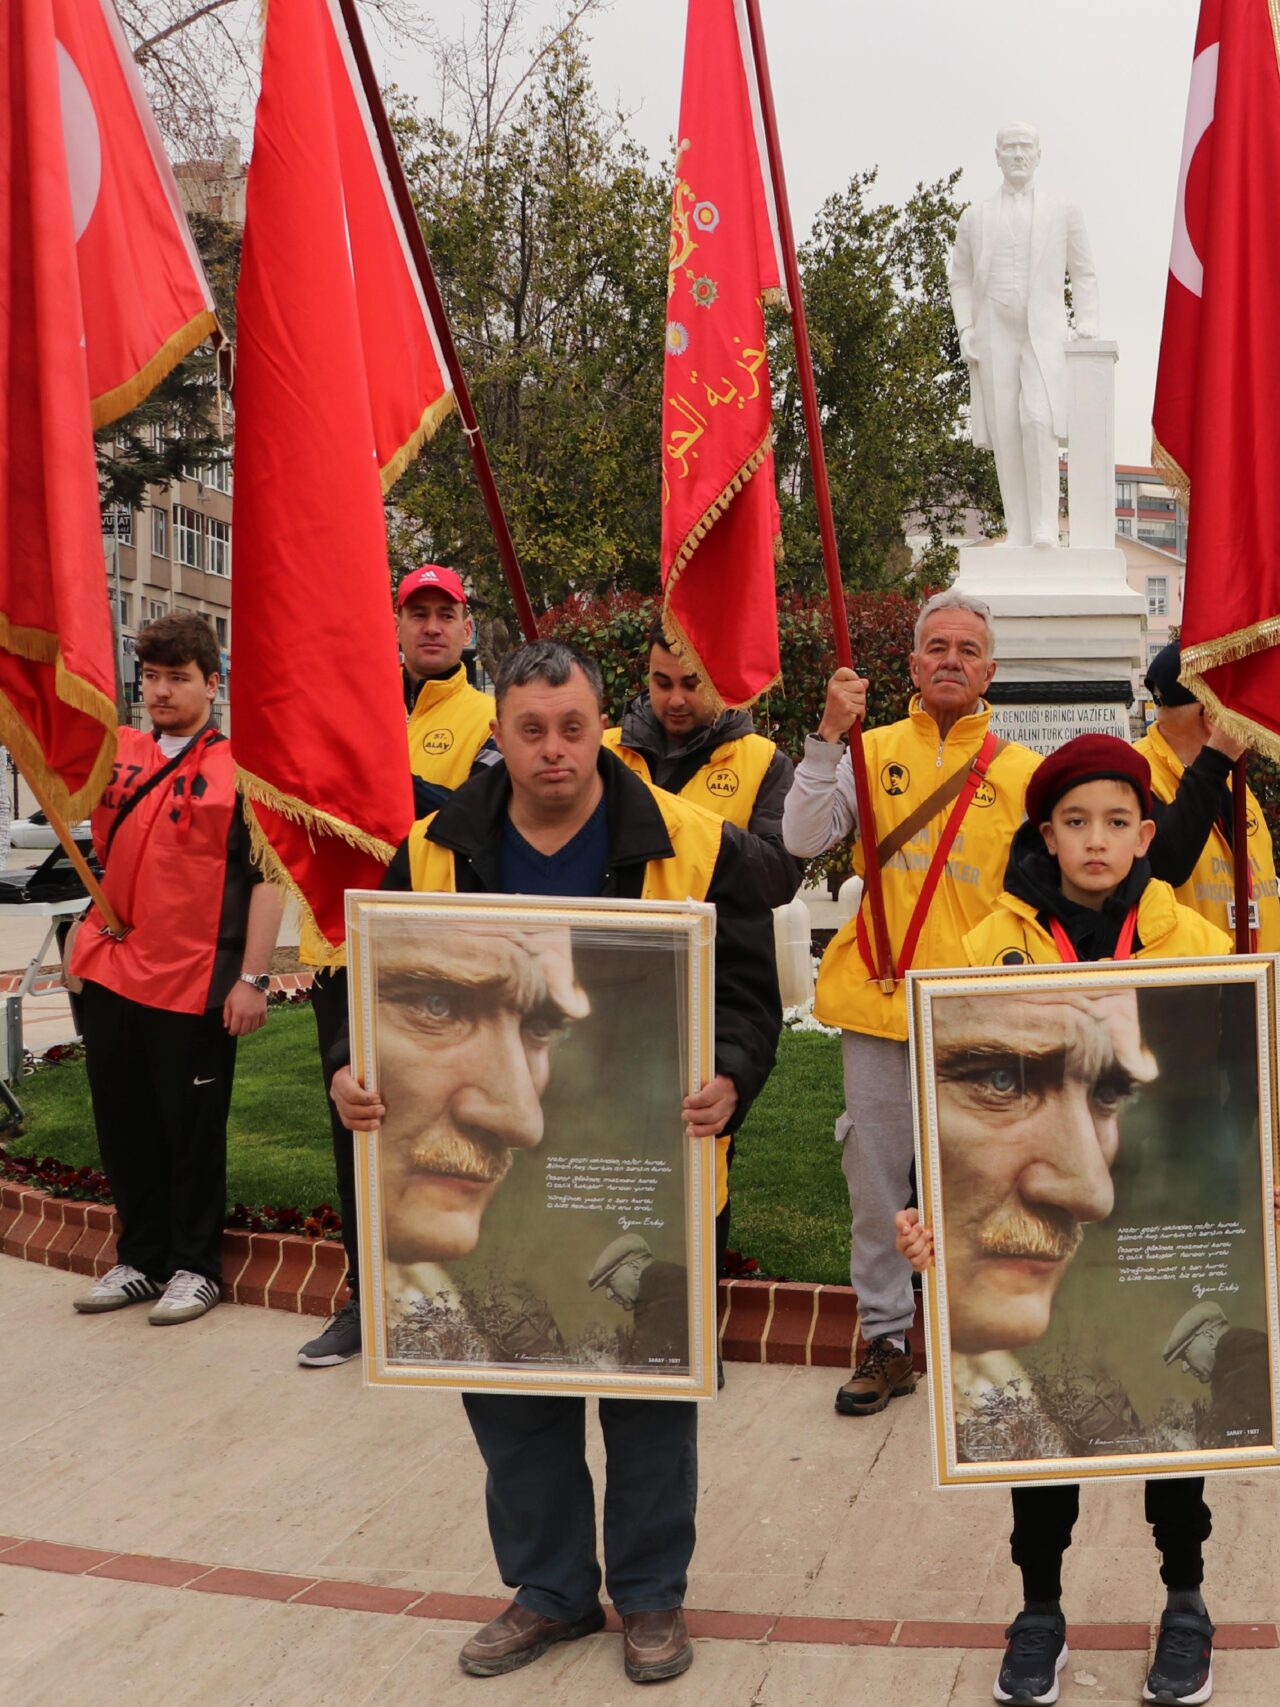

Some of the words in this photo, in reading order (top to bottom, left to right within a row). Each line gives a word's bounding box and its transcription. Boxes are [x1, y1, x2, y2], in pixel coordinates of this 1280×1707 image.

[425, 742, 449, 750] ALAY
[710, 783, 736, 793] ALAY
[974, 791, 993, 803] LAY
